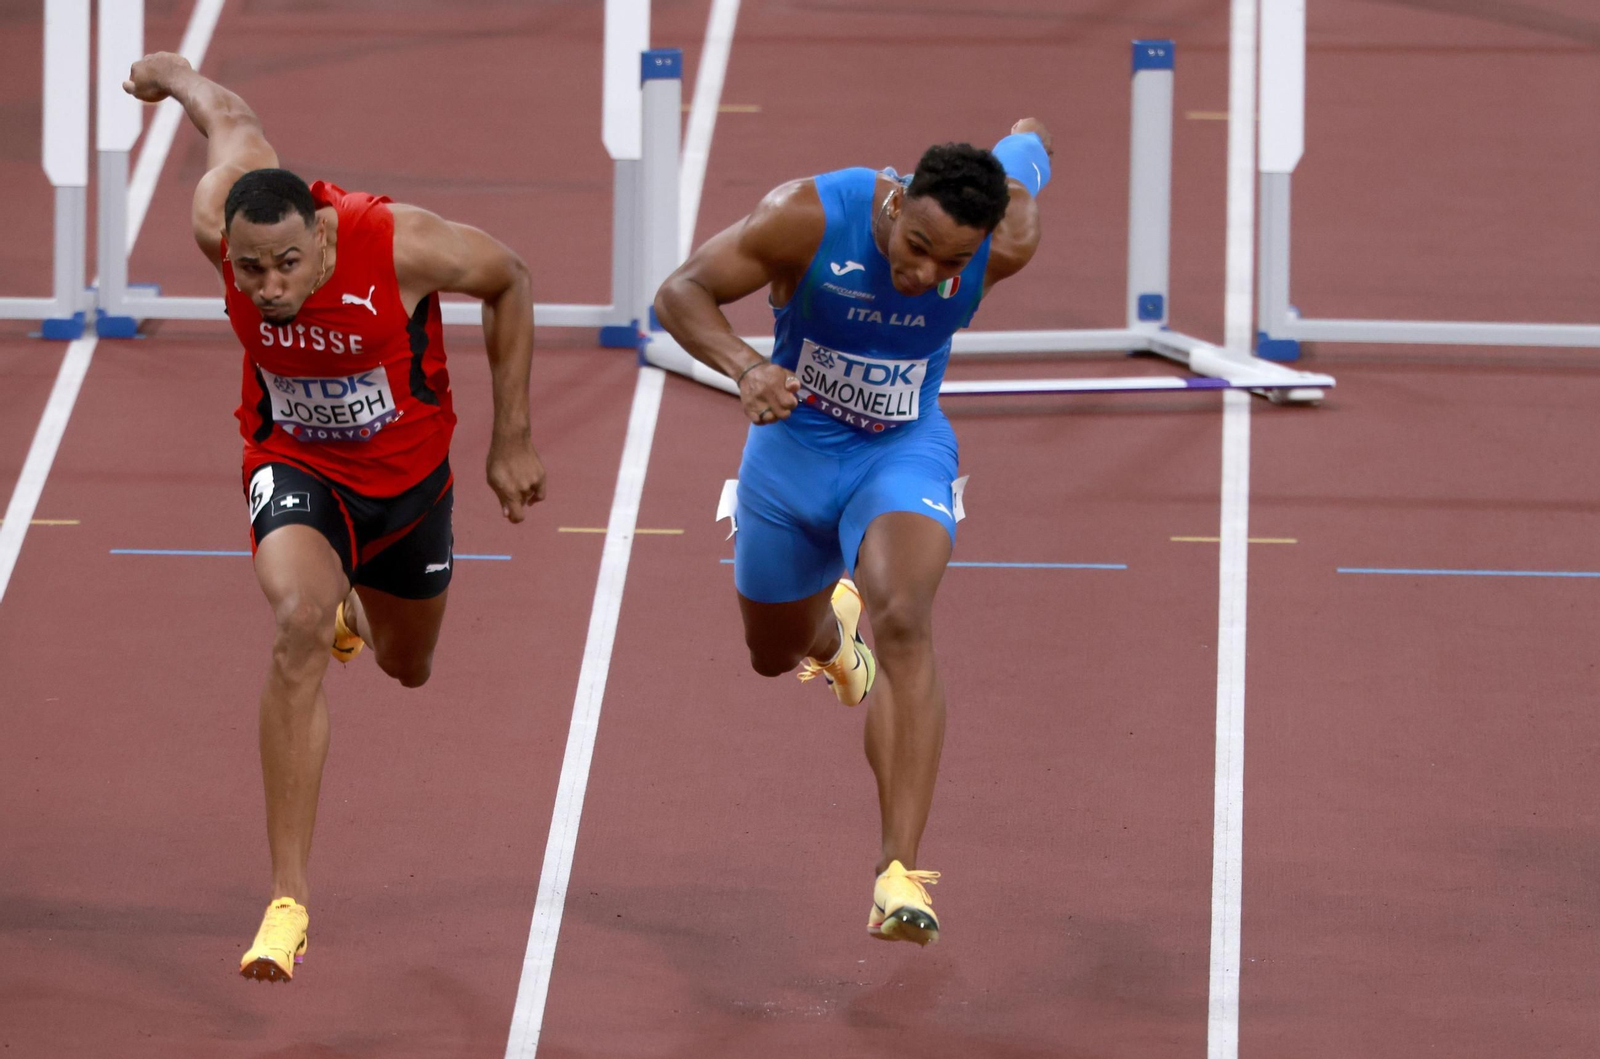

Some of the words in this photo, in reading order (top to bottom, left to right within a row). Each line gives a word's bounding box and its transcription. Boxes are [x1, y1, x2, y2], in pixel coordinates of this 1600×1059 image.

[847, 307, 926, 327] ITALIA
[260, 322, 364, 355] SUISSE
[293, 371, 378, 399] TDK
[837, 354, 917, 387] TDK
[280, 389, 386, 425] JOSEPH
[802, 365, 914, 416] SIMONELLI
